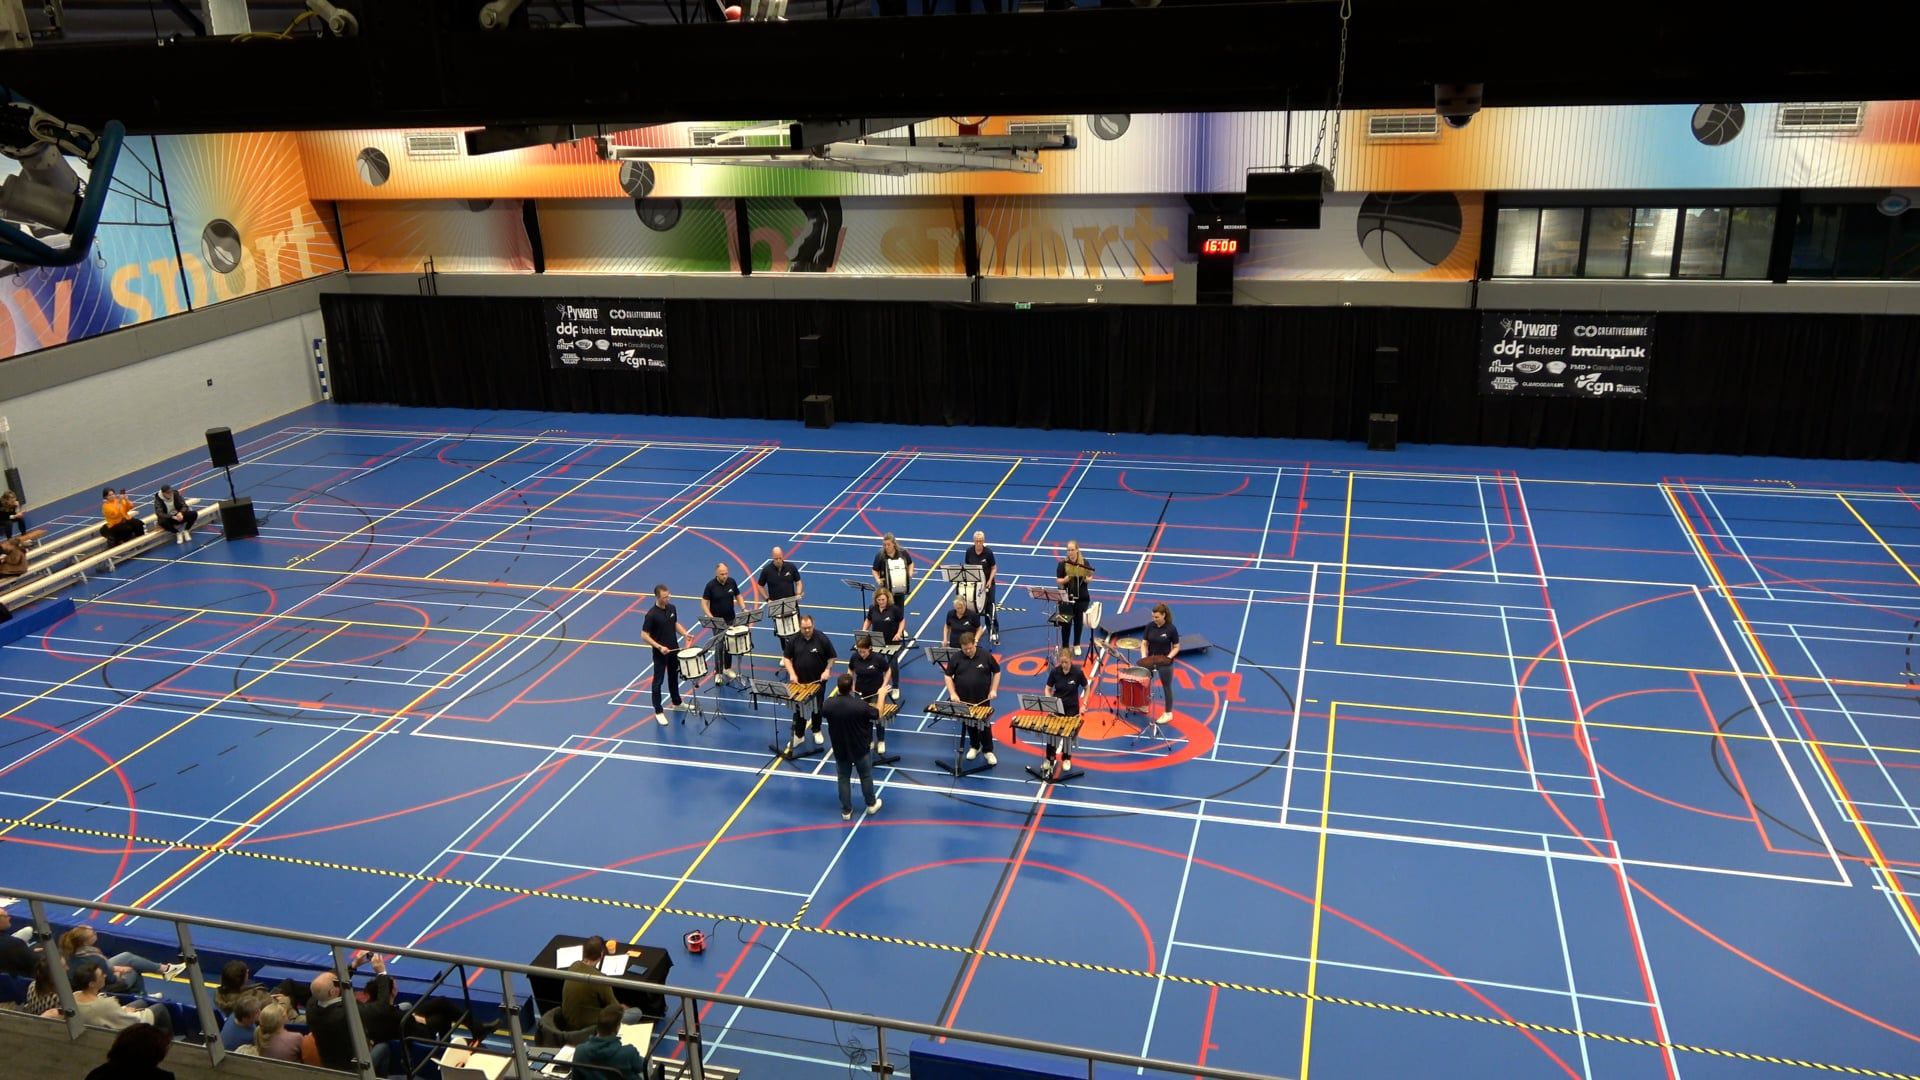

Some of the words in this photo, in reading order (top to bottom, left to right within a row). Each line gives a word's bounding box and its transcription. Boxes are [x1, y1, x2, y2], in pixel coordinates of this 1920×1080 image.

[1205, 240, 1237, 252] 16:00
[566, 305, 598, 321] Pyware
[556, 322, 579, 338] ddf
[581, 326, 606, 335] beheer
[610, 326, 664, 338] brainpink
[1514, 320, 1558, 339] Pyware
[1493, 339, 1525, 359] ddf
[1528, 344, 1566, 355] beheer
[1571, 345, 1646, 360] brainpink
[626, 356, 647, 369] cgn
[1586, 382, 1614, 395] cgn
